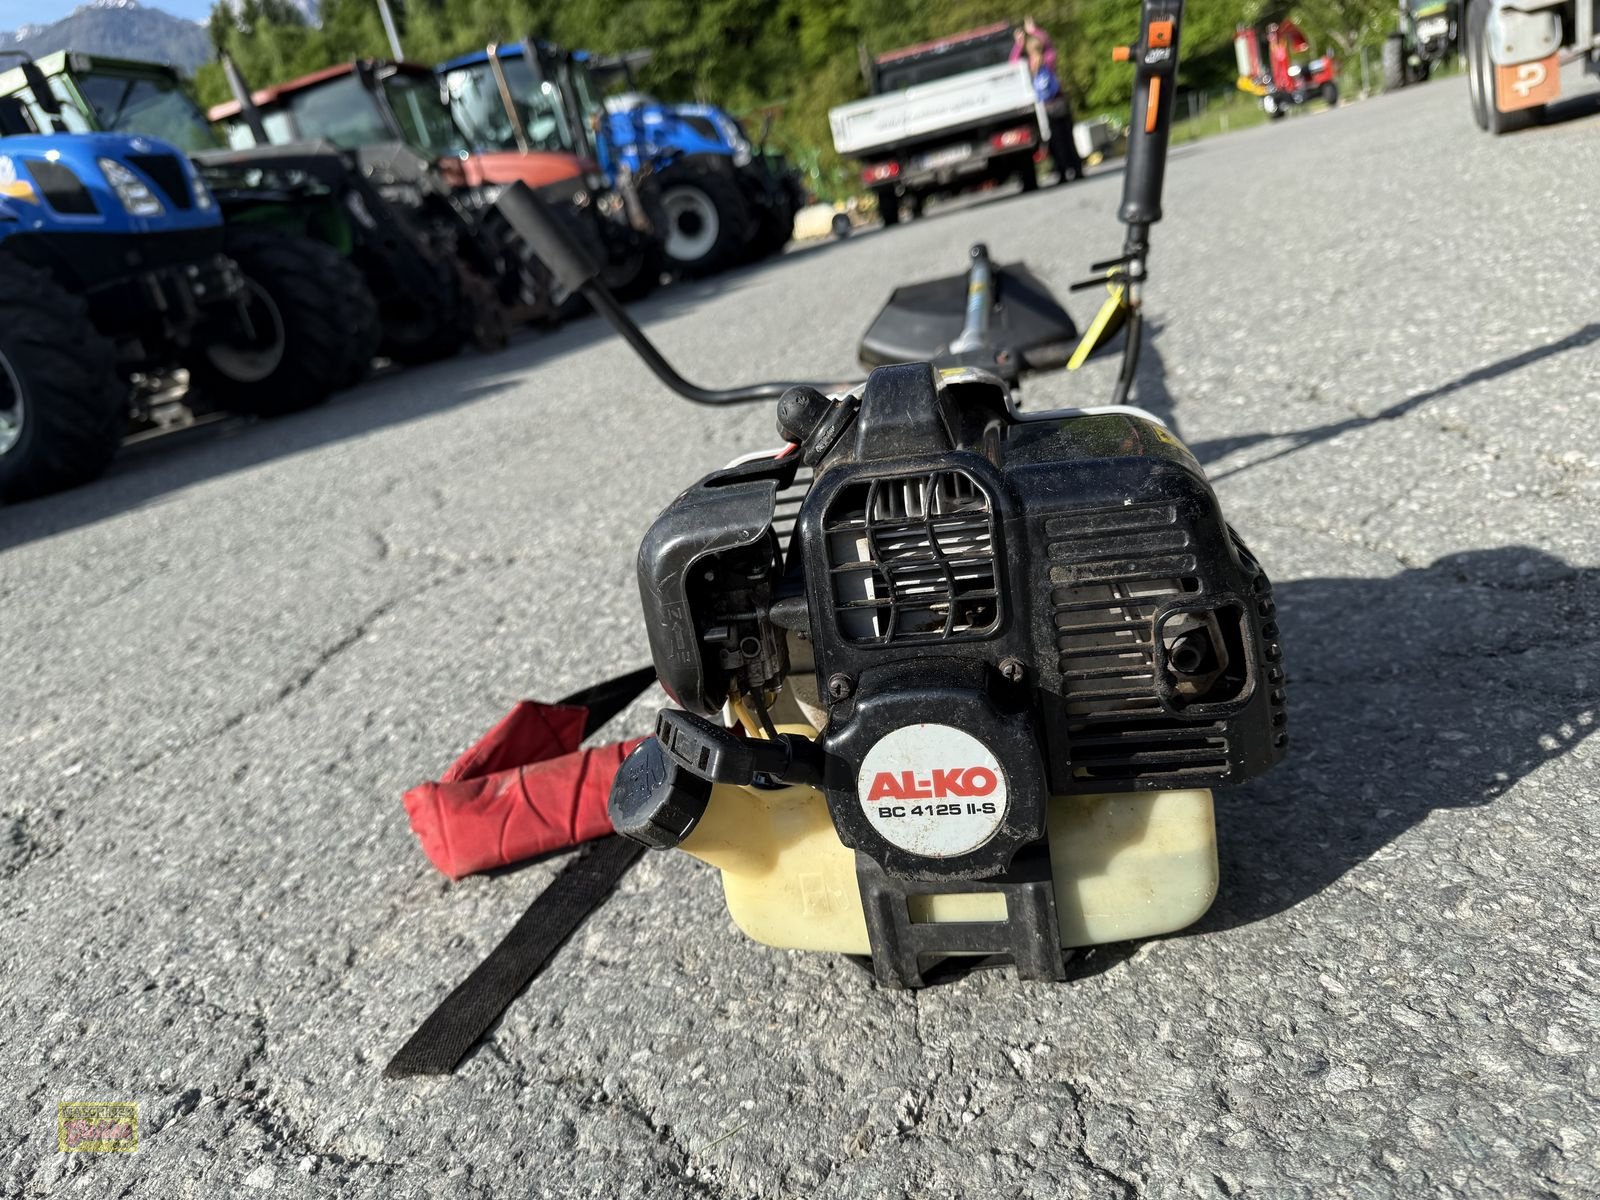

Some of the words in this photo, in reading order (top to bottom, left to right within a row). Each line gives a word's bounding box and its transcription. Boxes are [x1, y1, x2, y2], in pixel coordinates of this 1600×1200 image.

[867, 766, 998, 801] AL-KO
[878, 806, 906, 818] BC
[911, 804, 962, 816] 4125
